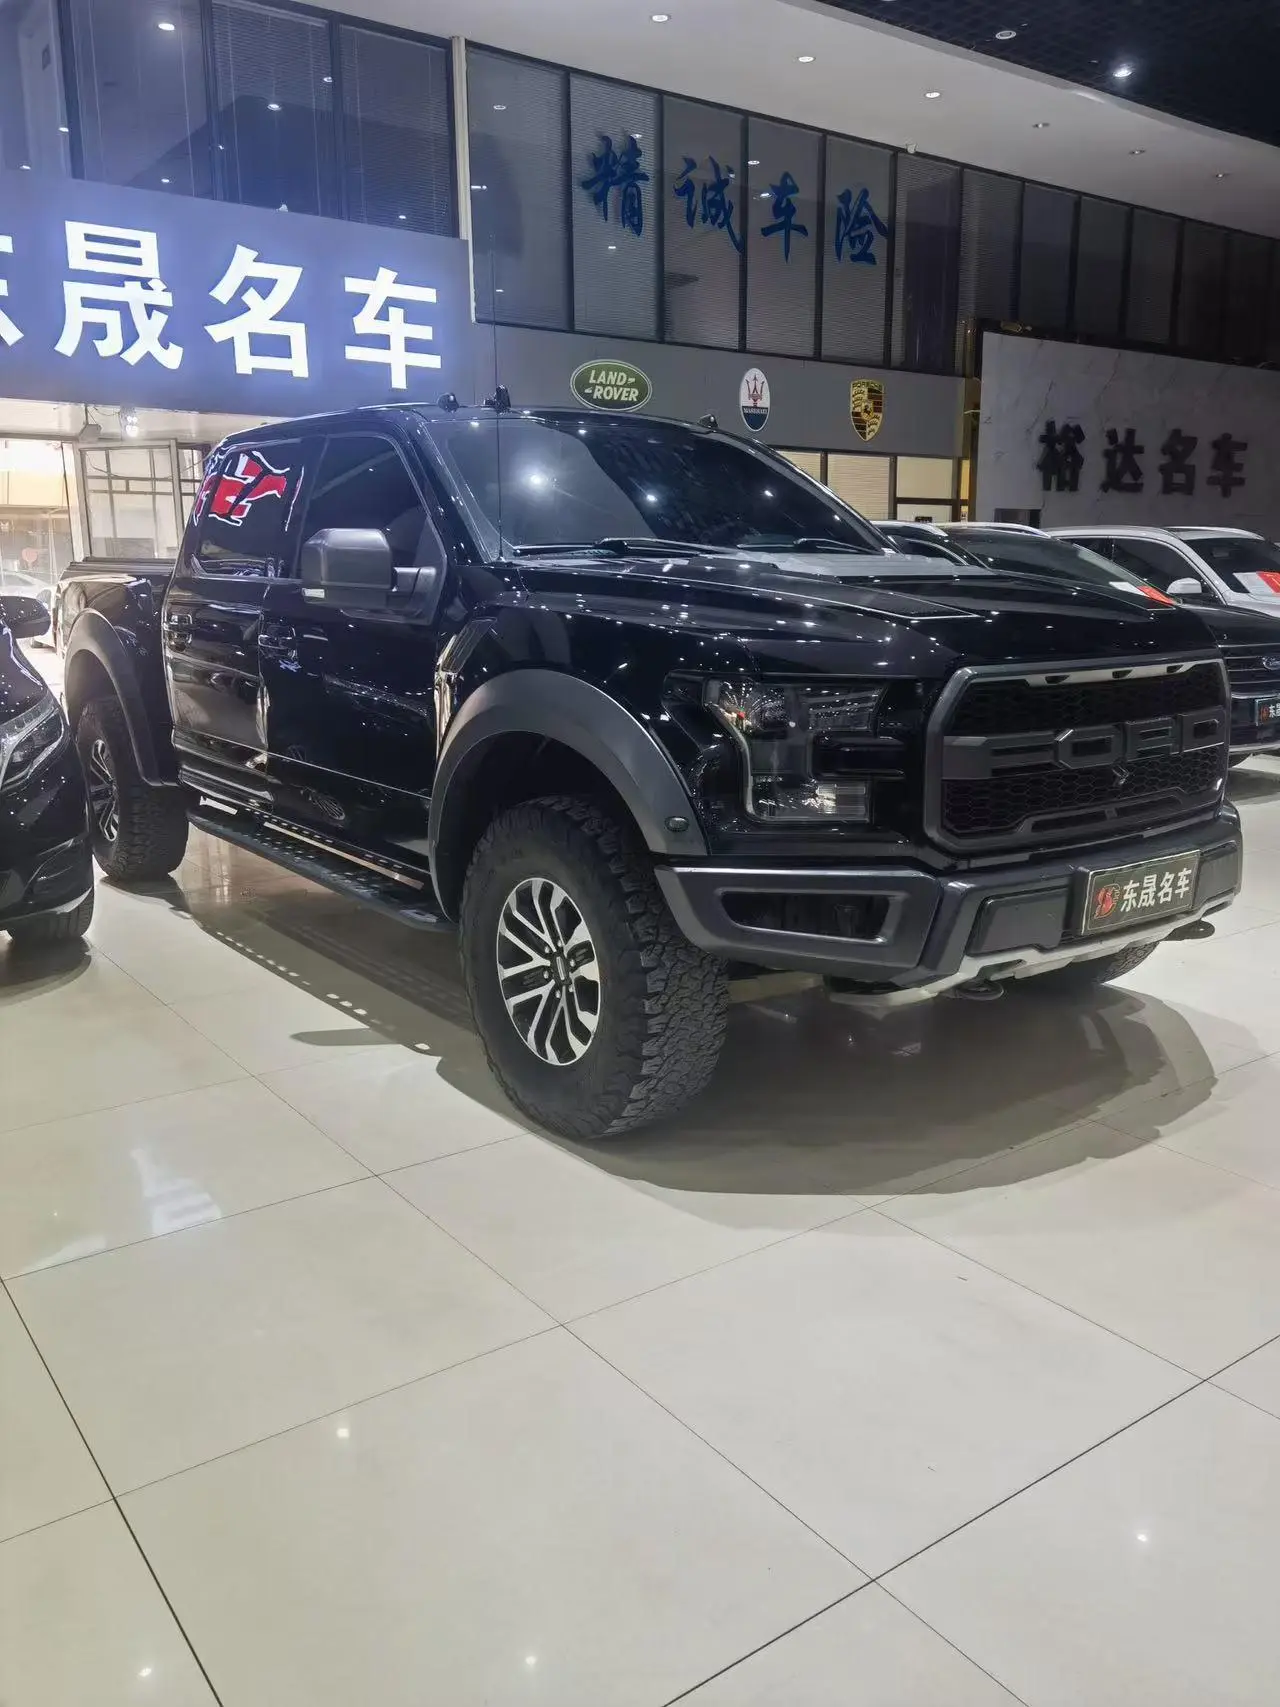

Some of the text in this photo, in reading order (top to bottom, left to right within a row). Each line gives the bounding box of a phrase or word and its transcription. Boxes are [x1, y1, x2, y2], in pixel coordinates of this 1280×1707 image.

[0, 220, 442, 389] 晟名车
[589, 369, 628, 386] LAND
[592, 385, 640, 401] ROVER
[1036, 417, 1249, 498] 裕达名车
[1120, 867, 1192, 912] 东晟名车
